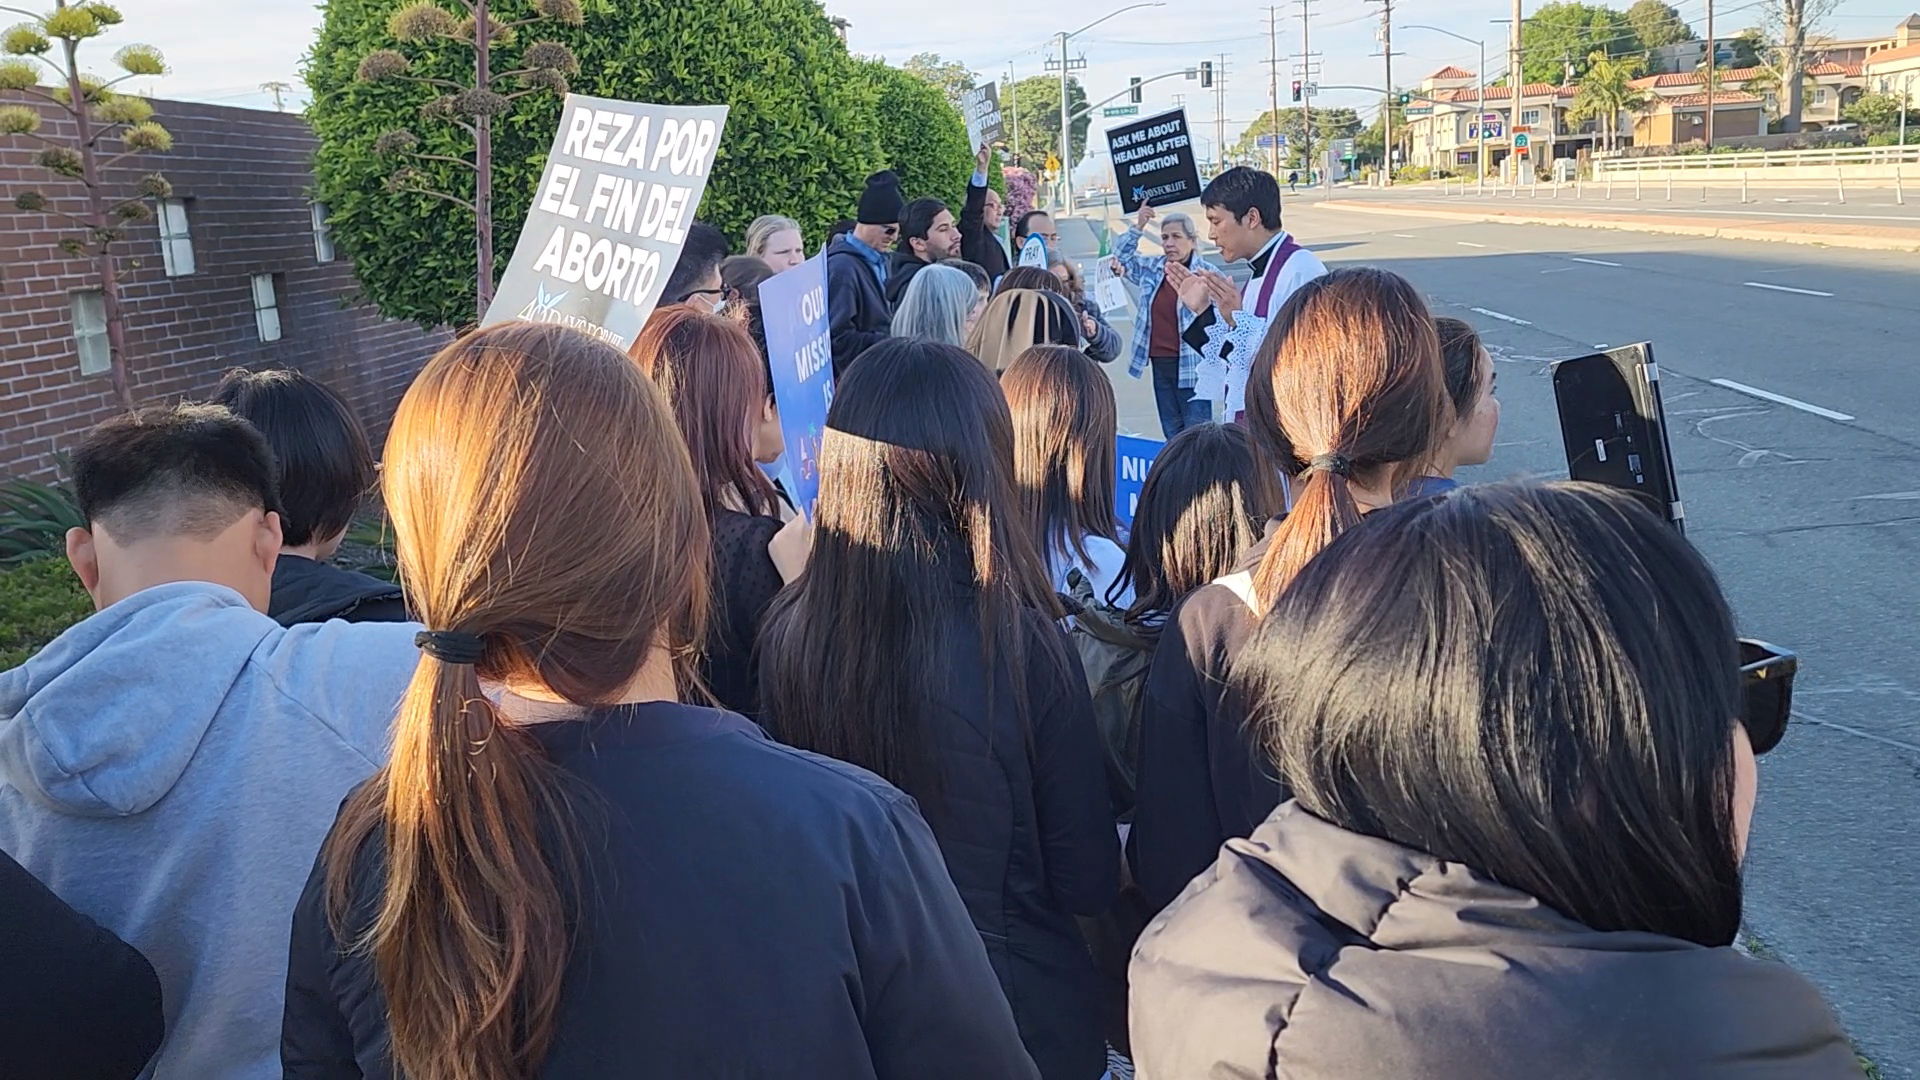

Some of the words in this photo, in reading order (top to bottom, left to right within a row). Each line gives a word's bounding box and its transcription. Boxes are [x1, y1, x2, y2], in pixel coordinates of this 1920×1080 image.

[562, 106, 651, 171] REZA
[650, 118, 716, 177] POR
[1112, 136, 1131, 149] ASK
[1131, 130, 1147, 144] ME
[1147, 119, 1181, 140] ABOUT
[1114, 144, 1155, 164] HEALING
[1156, 134, 1188, 154] AFTER
[1129, 153, 1179, 177] ABORTION
[538, 163, 582, 219] EL
[584, 173, 645, 234] FIN
[639, 183, 693, 245] DEL
[532, 225, 662, 307] ABORTO
[802, 285, 825, 326] OUR
[795, 328, 831, 384] MISSIO
